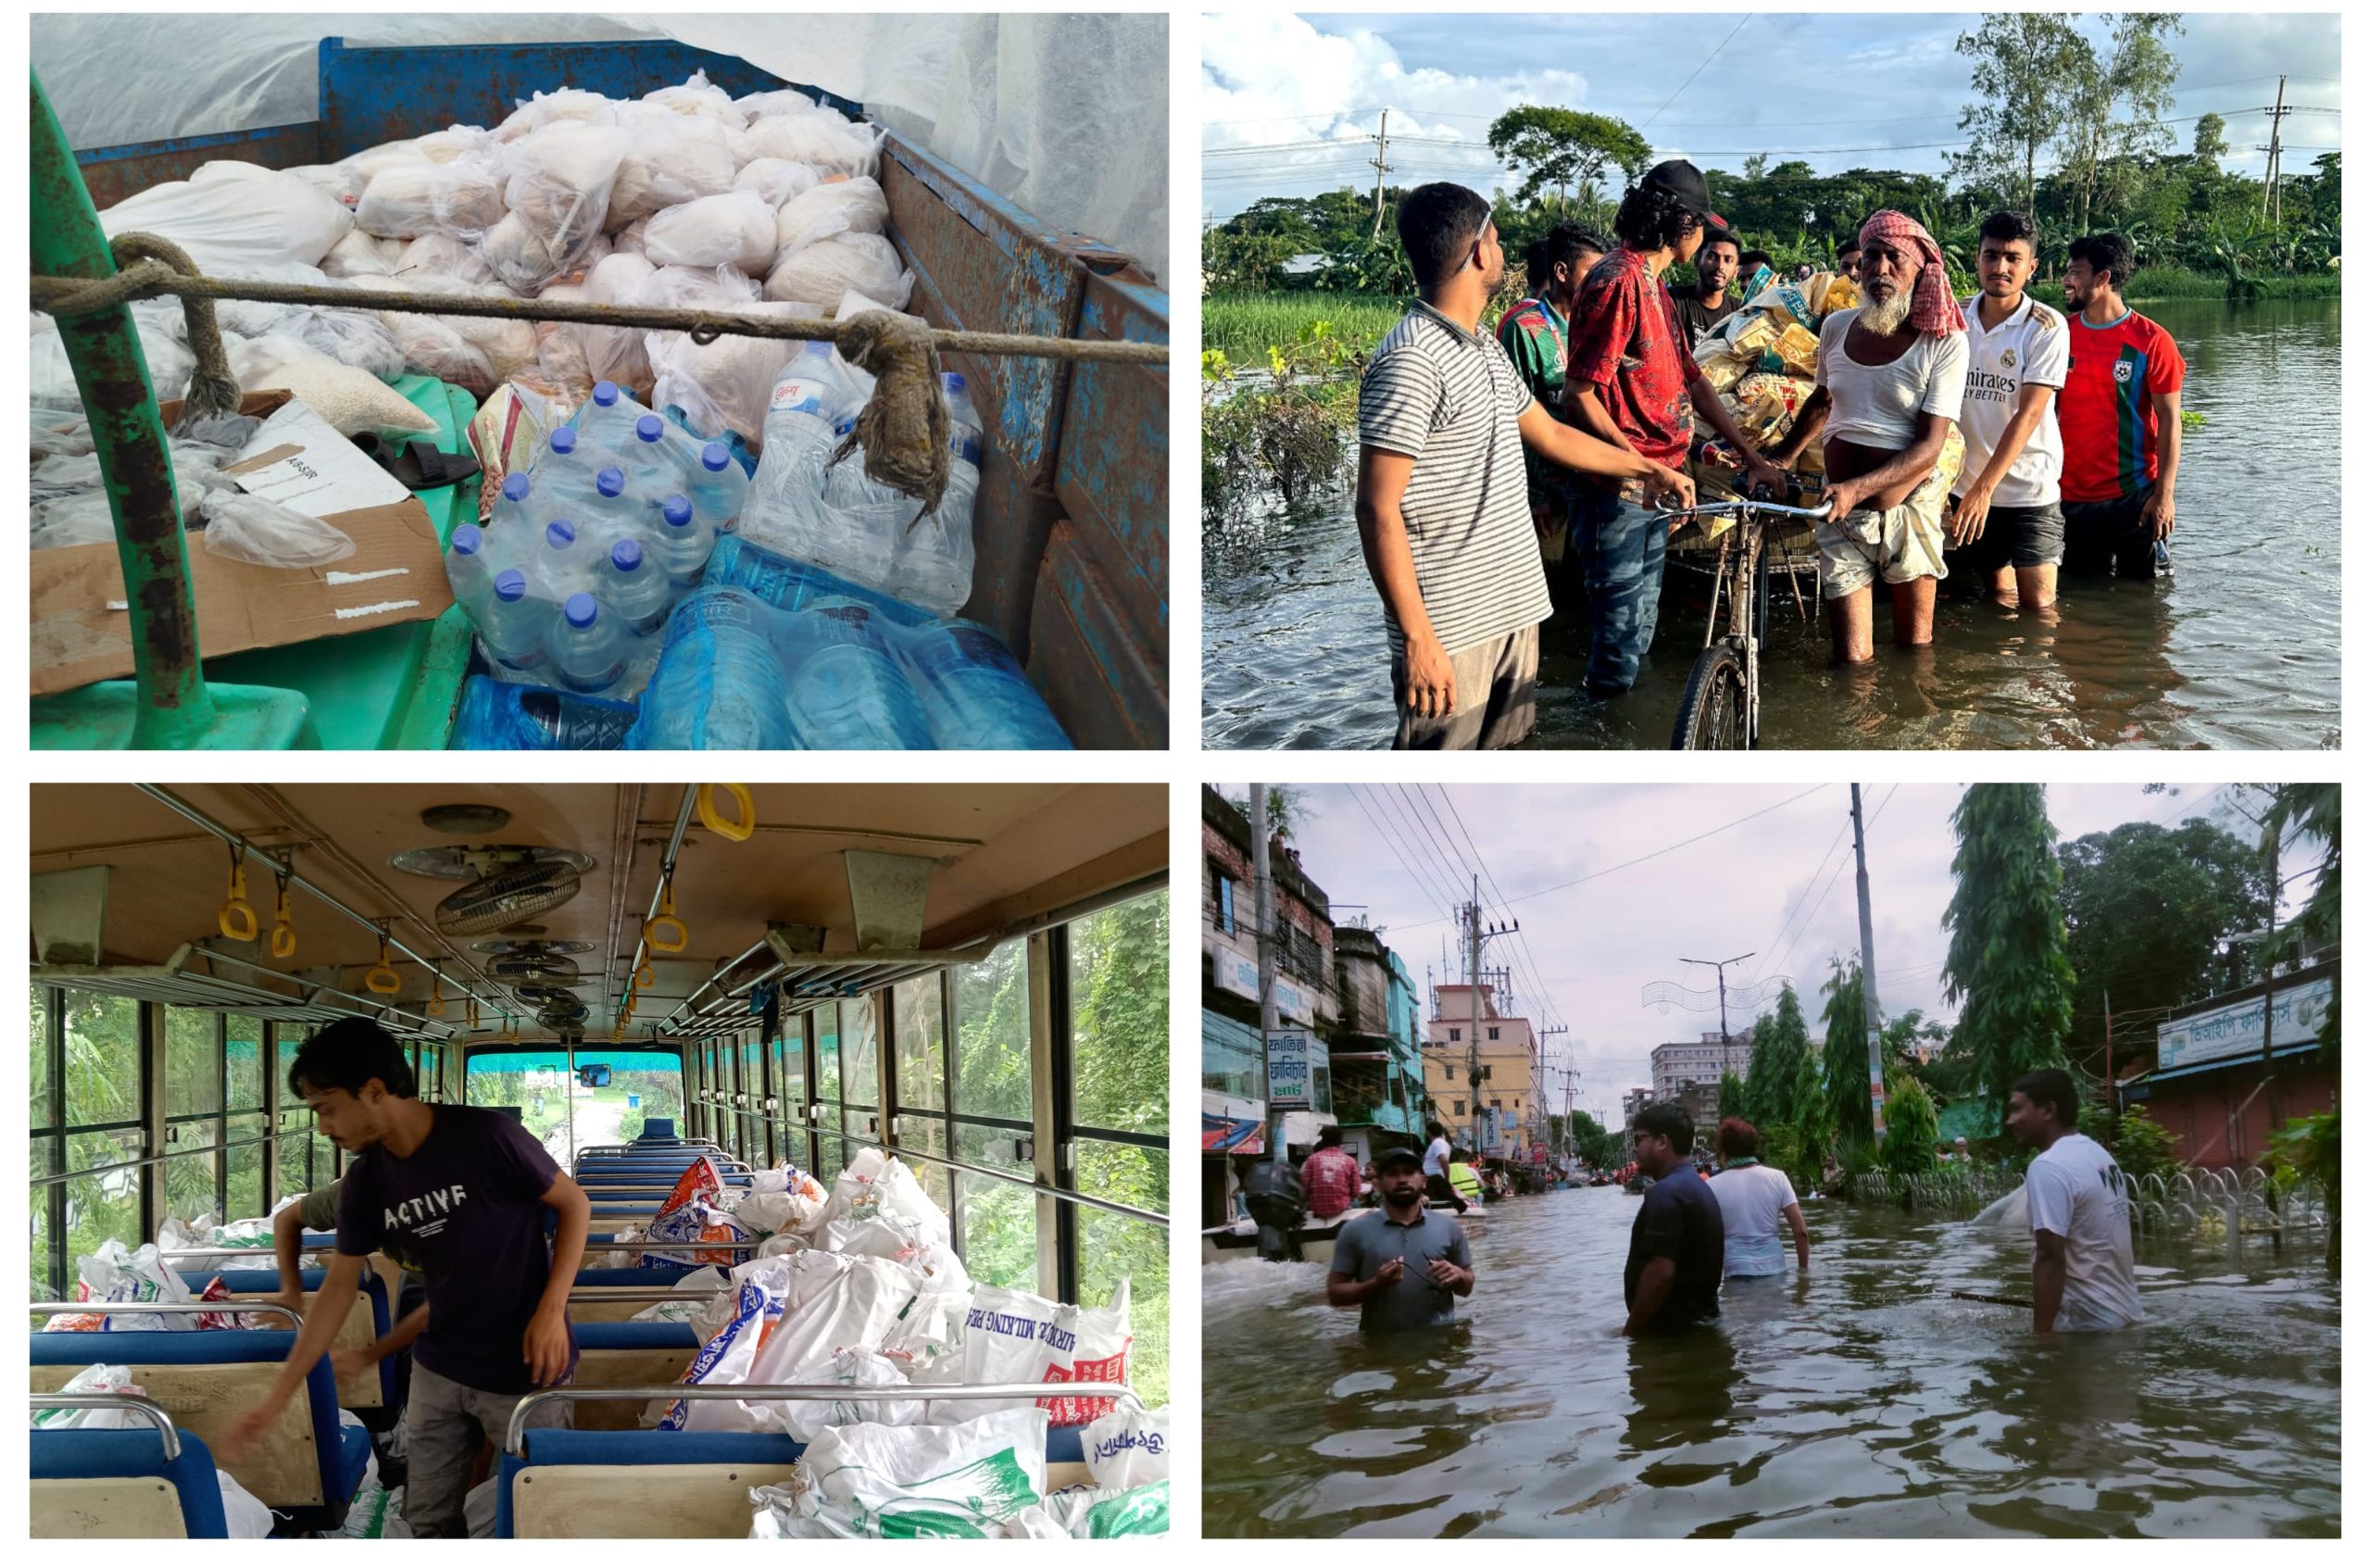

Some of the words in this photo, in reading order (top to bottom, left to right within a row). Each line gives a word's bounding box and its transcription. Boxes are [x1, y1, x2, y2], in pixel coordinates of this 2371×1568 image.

[1966, 367, 2016, 393] mirates
[1963, 388, 1975, 399] LY
[1975, 389, 2007, 403] BETTER
[1487, 1108, 1495, 1146] MARCEL
[986, 1311, 1036, 1340] MILKING
